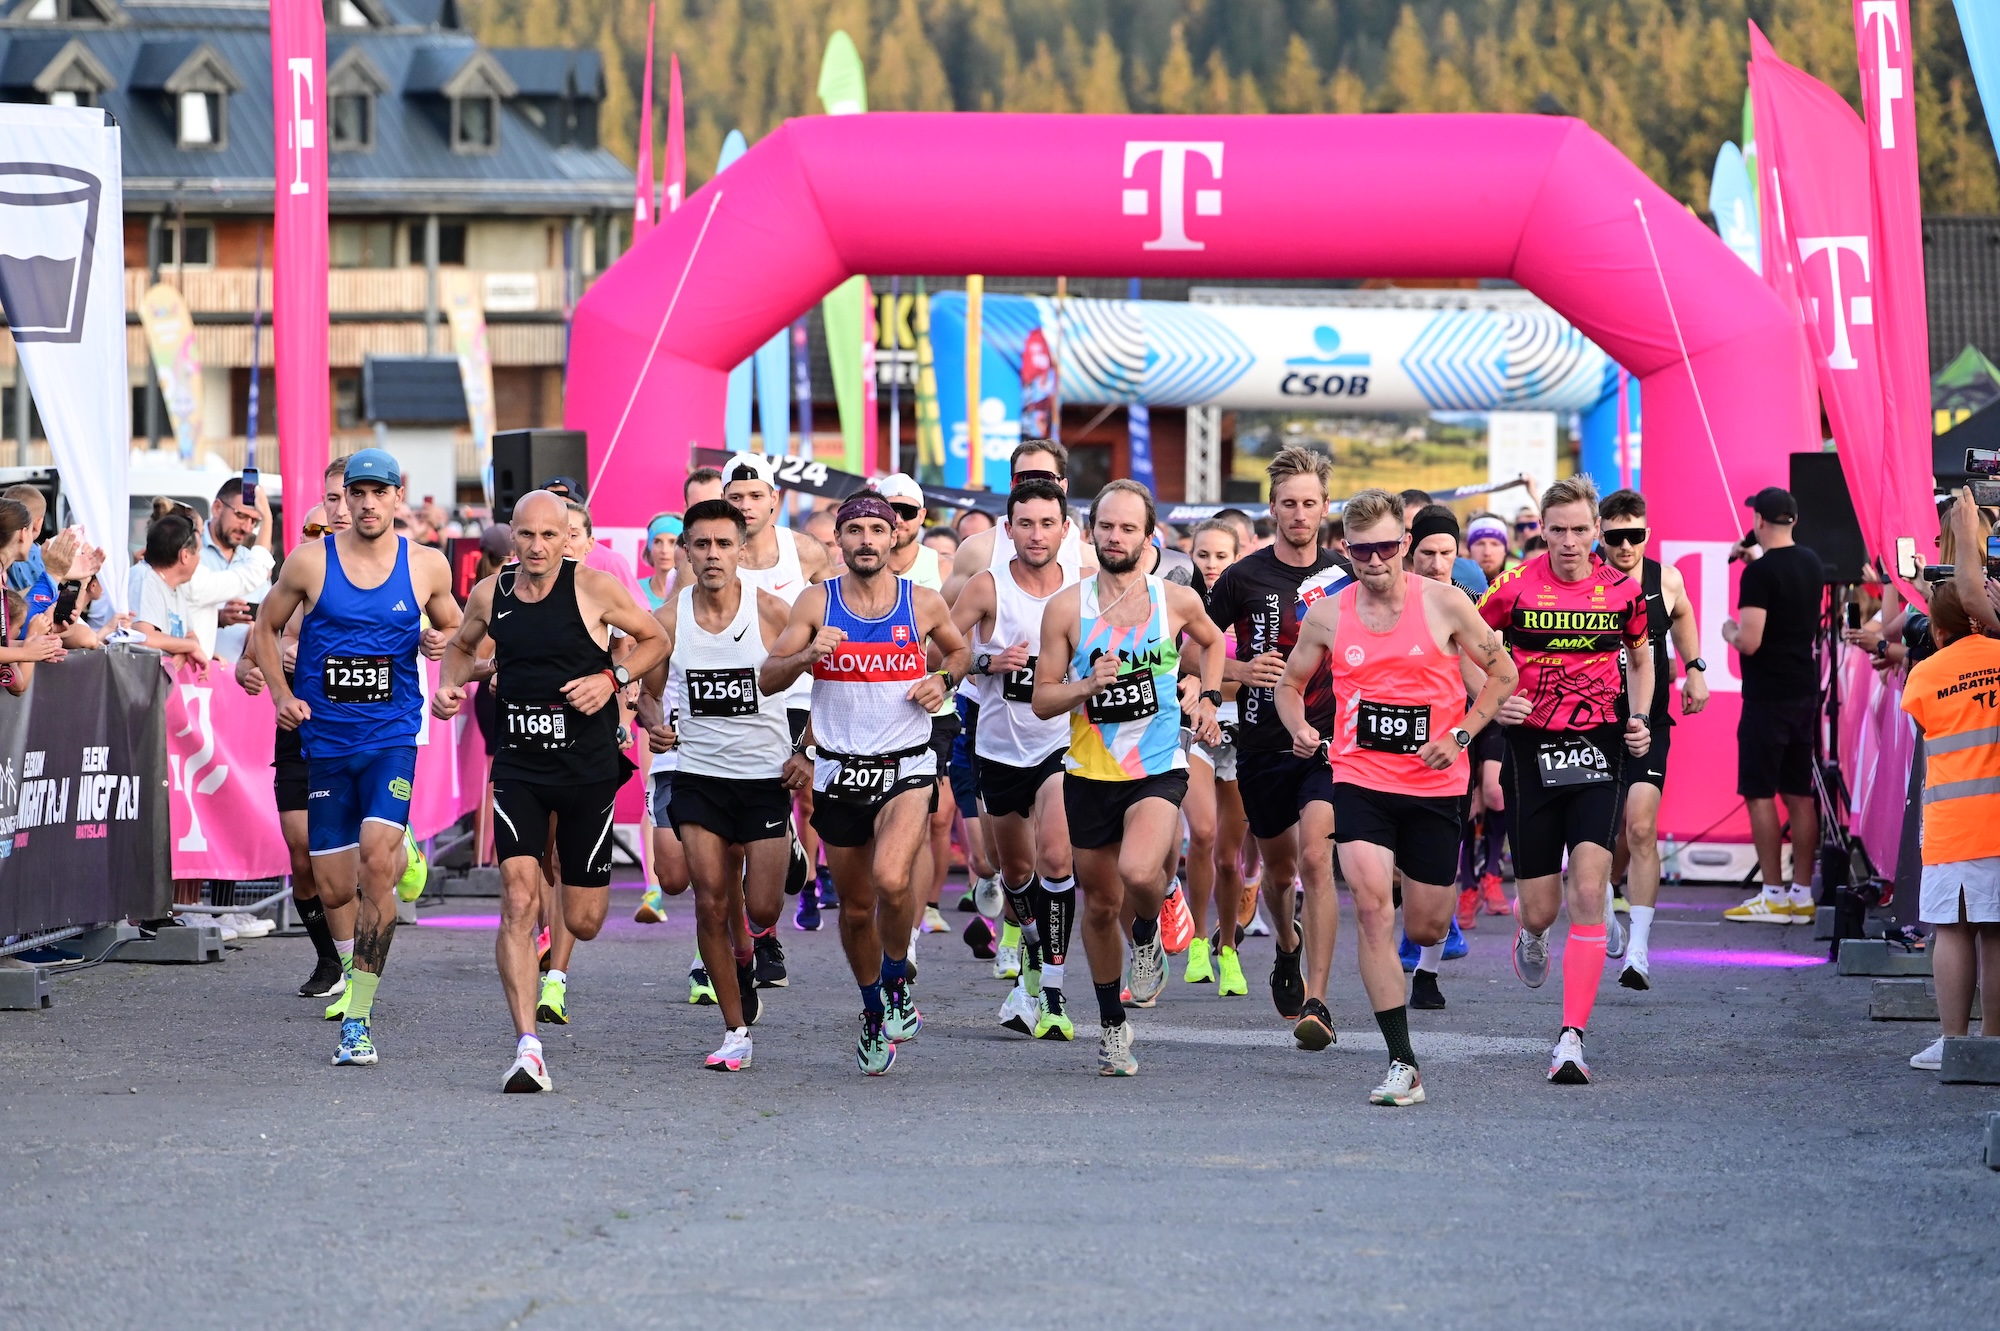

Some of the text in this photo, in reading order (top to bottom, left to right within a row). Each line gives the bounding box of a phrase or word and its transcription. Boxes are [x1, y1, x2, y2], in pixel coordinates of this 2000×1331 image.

[1123, 141, 1224, 250] T
[1266, 593, 1280, 643] MIKULÁŠ
[1523, 610, 1619, 630] ROHOZEC
[1547, 634, 1600, 651] AMIX
[821, 653, 918, 673] SLOVAKIA
[326, 668, 377, 687] 1253
[1958, 667, 2000, 681] BRATISL
[691, 680, 741, 700] 1256
[1092, 684, 1141, 708] 1233
[507, 713, 553, 735] 1168
[1368, 714, 1408, 737] 189
[1541, 747, 1594, 771] 1246
[834, 768, 883, 788] 1207
